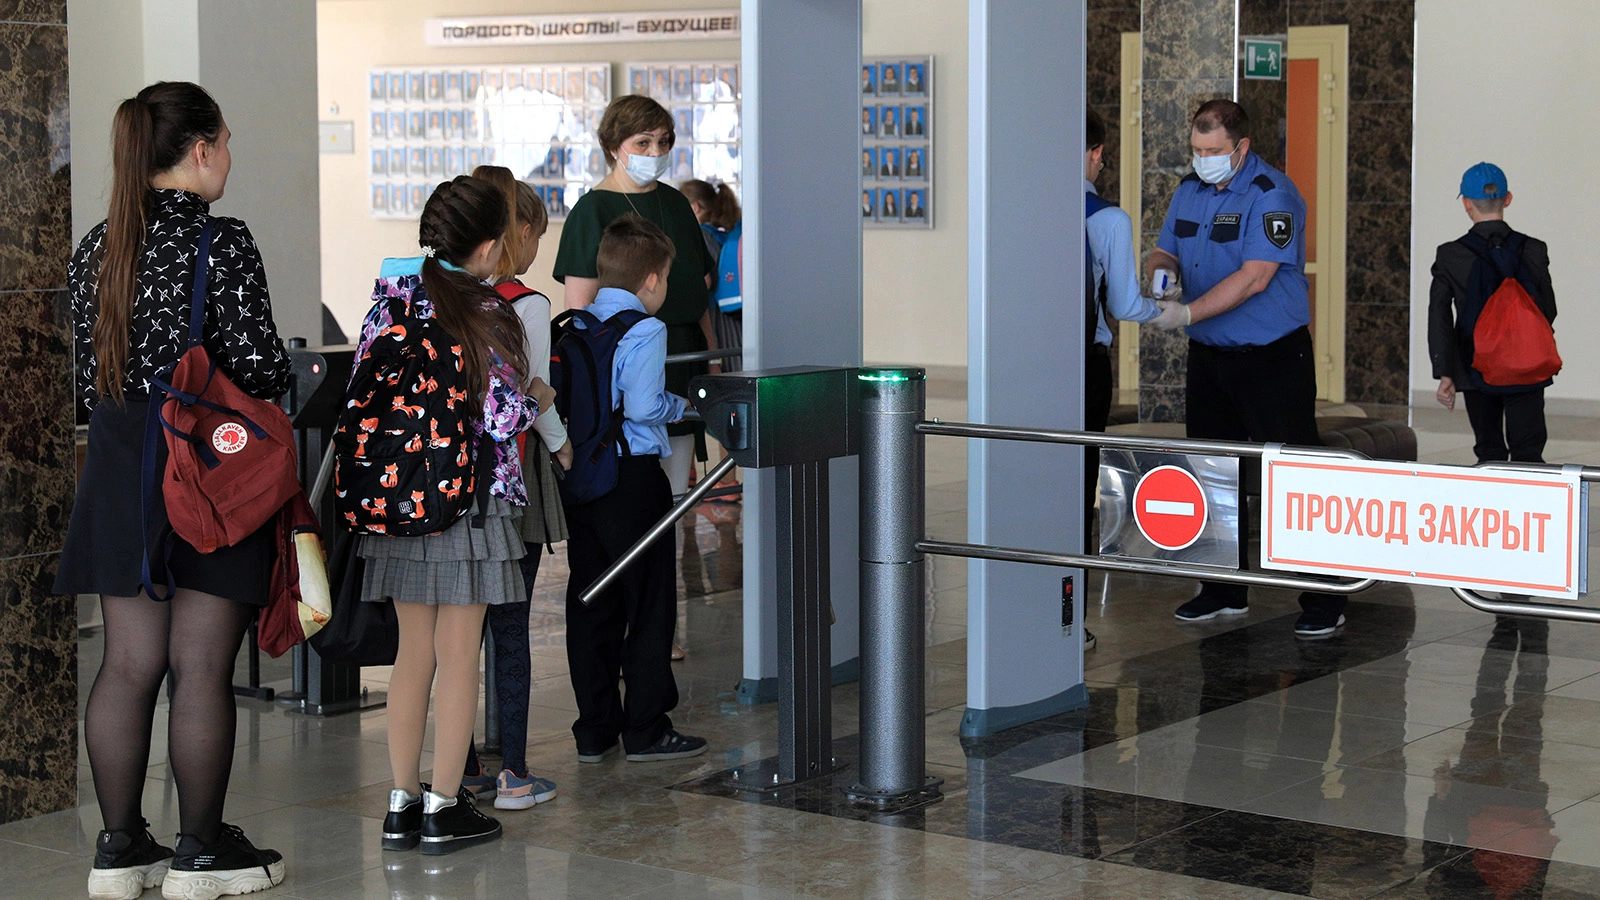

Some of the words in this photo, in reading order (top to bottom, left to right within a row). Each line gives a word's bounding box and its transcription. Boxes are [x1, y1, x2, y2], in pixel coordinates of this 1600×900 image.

[443, 24, 534, 38] ГОРДОСТЬ
[1286, 491, 1409, 546] ПРОХОД
[1418, 503, 1552, 553] ЗАКРЫТ
